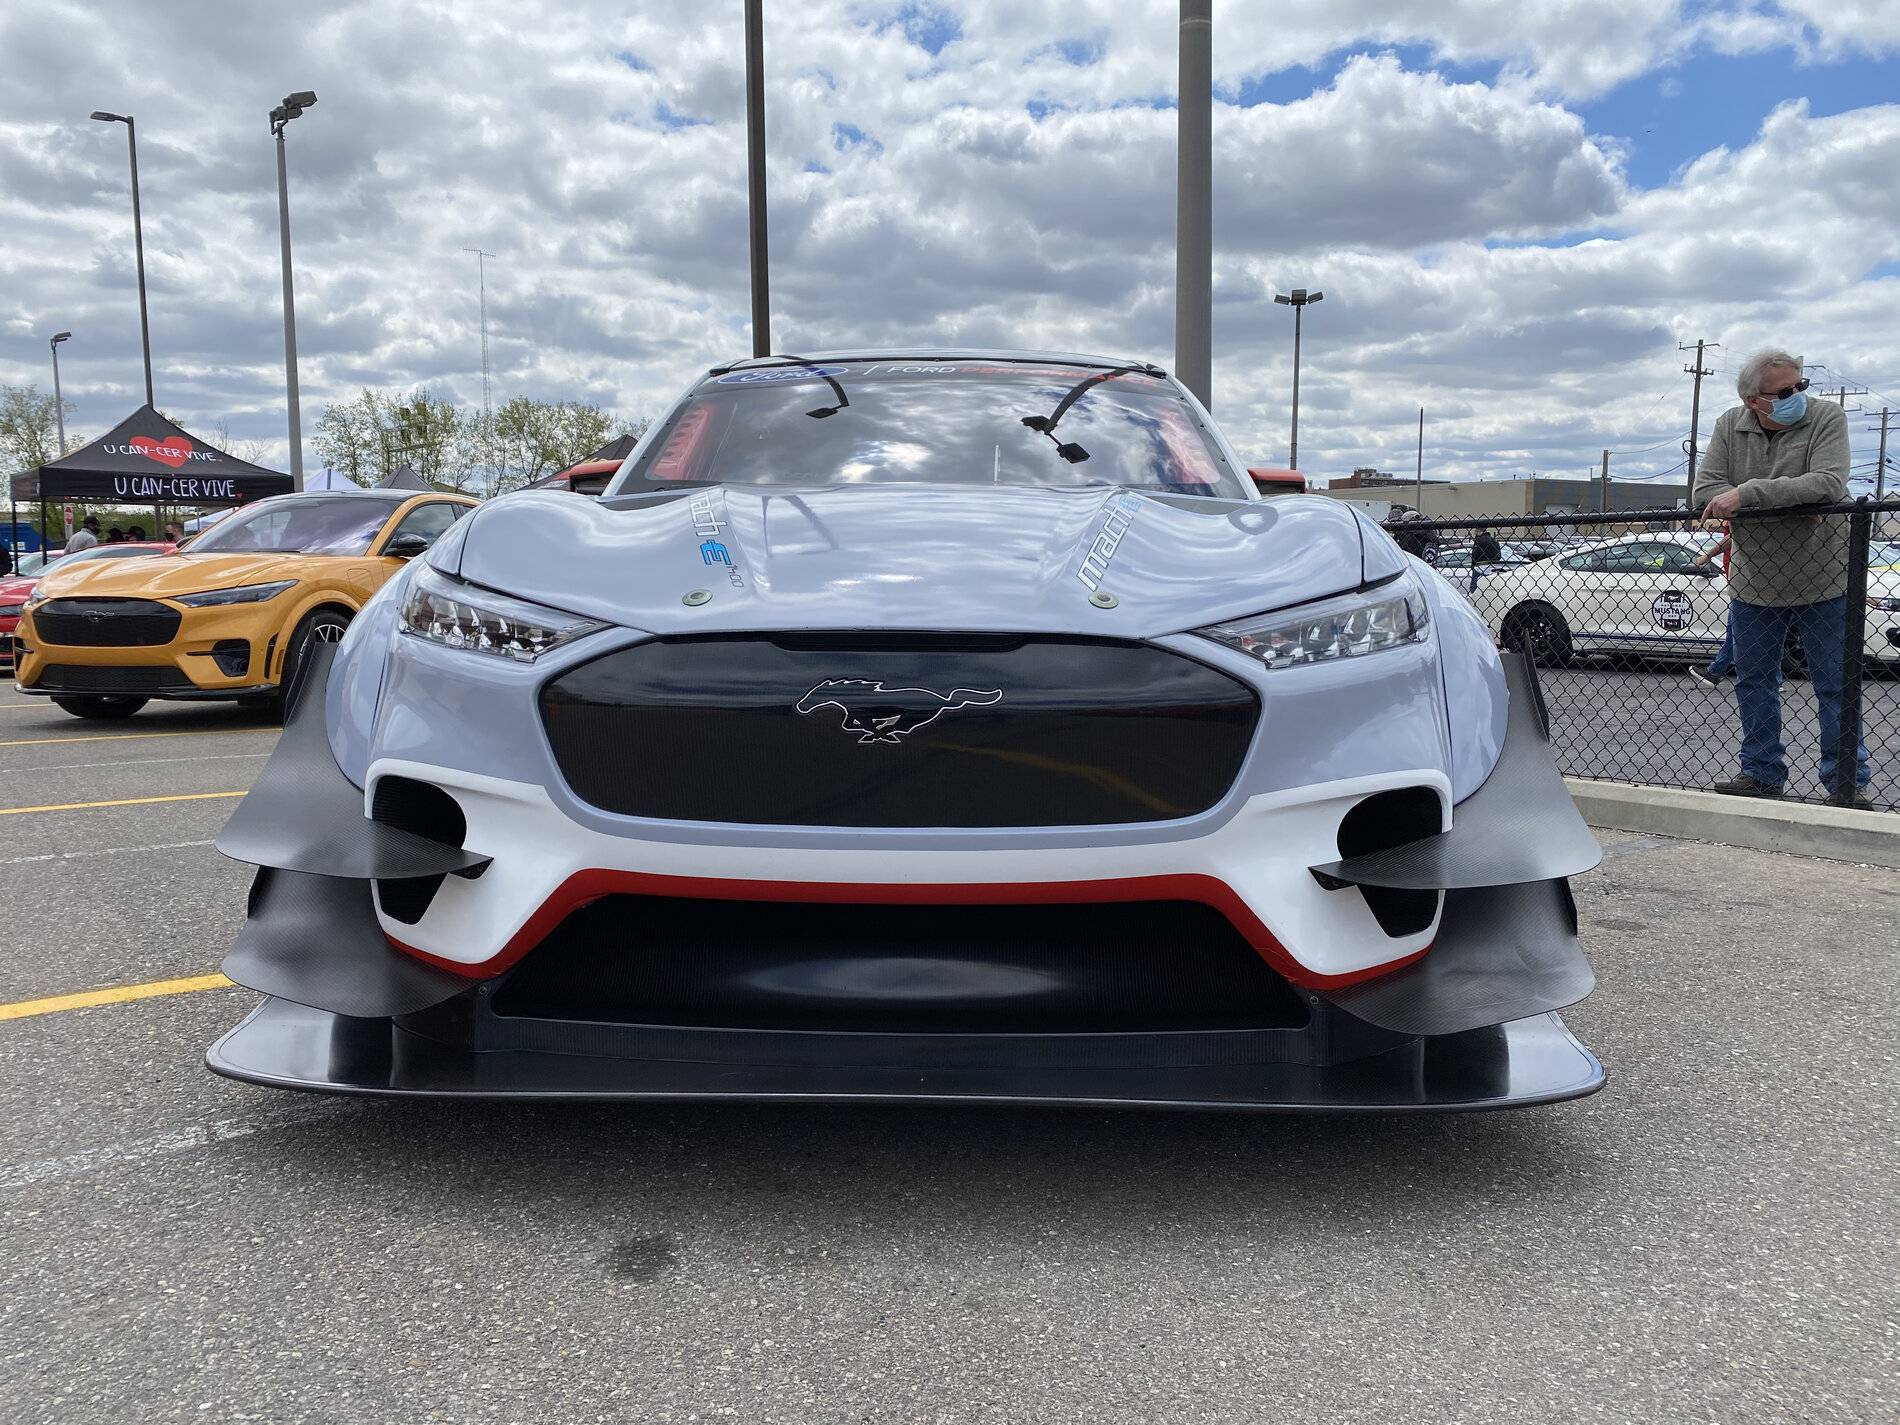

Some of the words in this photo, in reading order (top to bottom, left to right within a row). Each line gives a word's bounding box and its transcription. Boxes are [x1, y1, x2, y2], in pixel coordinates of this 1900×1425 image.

[103, 444, 116, 454] U
[120, 445, 182, 458] CAN-CER
[114, 477, 127, 495] U
[131, 477, 199, 497] CAN-CER
[202, 479, 236, 497] VIVE
[1654, 607, 1691, 615] MUSTANG
